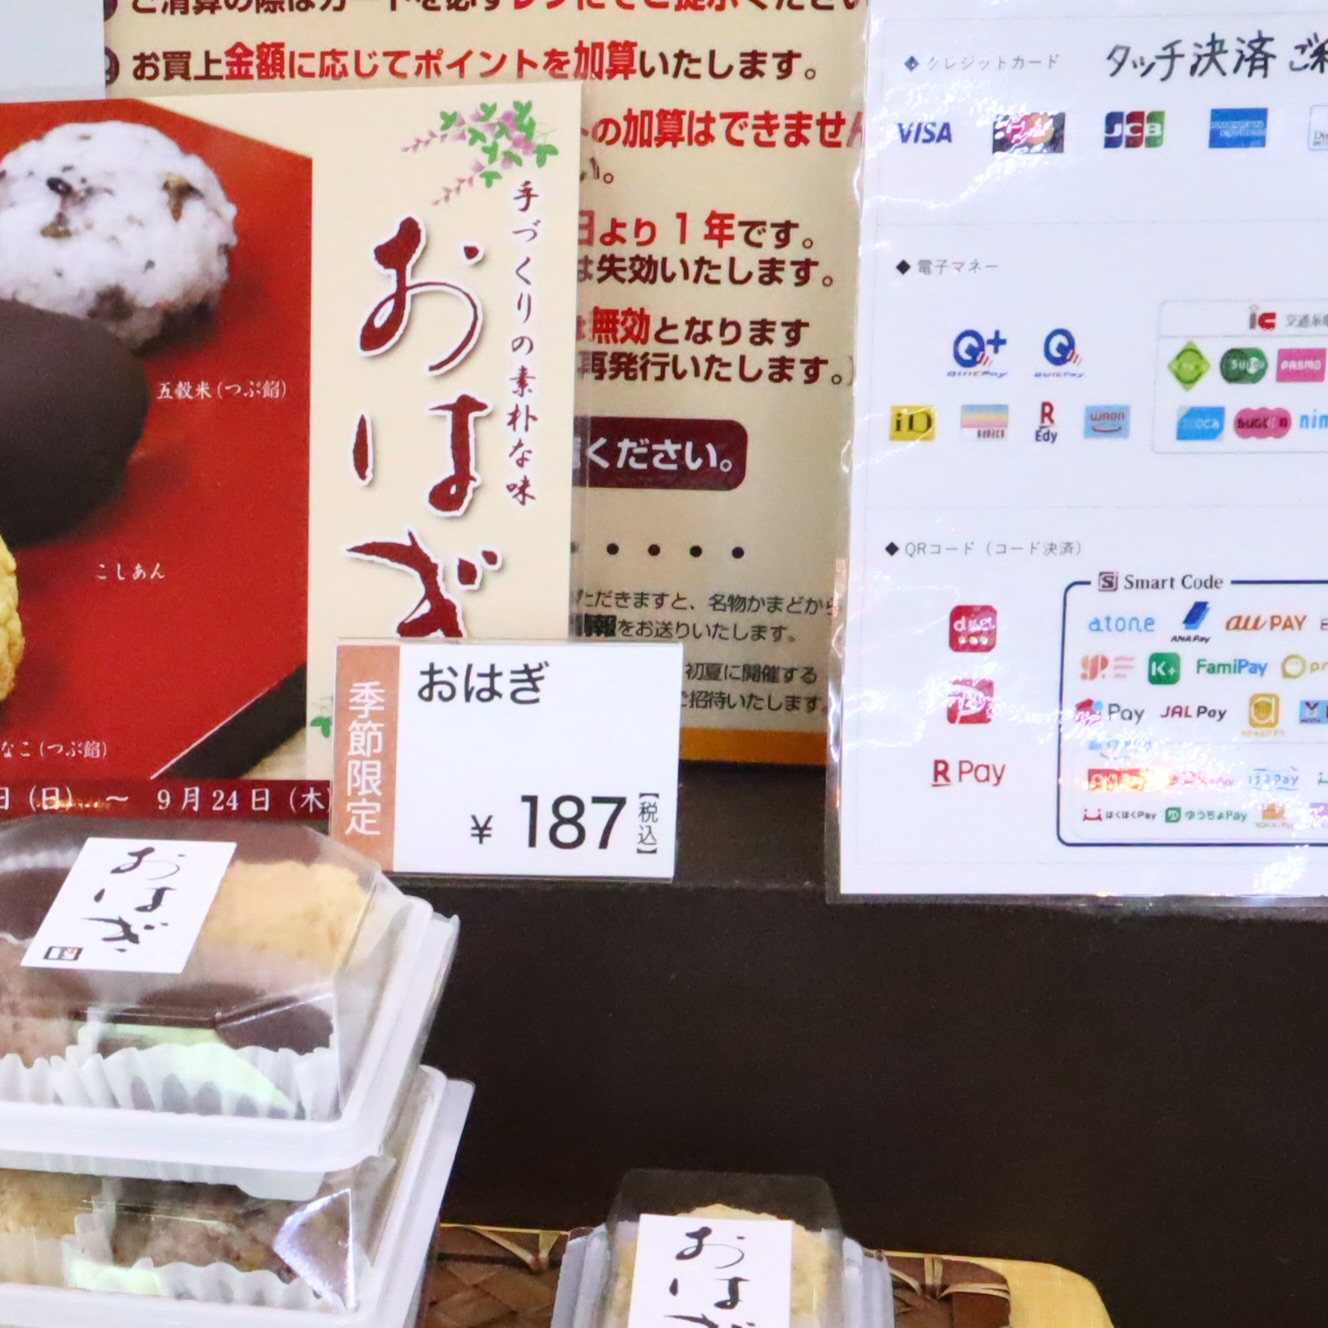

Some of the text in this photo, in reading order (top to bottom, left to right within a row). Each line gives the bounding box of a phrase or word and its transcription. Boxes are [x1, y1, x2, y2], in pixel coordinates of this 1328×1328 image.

[132, 41, 816, 81] お買上金額に応じてポイントを加算いたします。
[1106, 29, 1277, 82] タッチ決済
[897, 122, 953, 144] VISA
[917, 258, 1000, 275] 電子マネー
[506, 180, 542, 507] 手づくりの素朴な味
[1035, 429, 1058, 444] Edy
[96, 562, 166, 580] こしあん
[1123, 573, 1224, 590] Smart Code
[1088, 615, 1156, 632] atone
[1270, 615, 1308, 631] PAY
[685, 662, 818, 685] 初夏に開催する
[1196, 658, 1268, 677] FamiPay
[416, 661, 551, 706] おはぎ
[1108, 703, 1145, 725] Pay
[1160, 705, 1228, 721] JAL Pay
[344, 681, 386, 836] 季節限定
[958, 759, 1006, 787] Pay
[470, 794, 628, 850] ¥ 187
[80, 846, 186, 953] おはぎ
